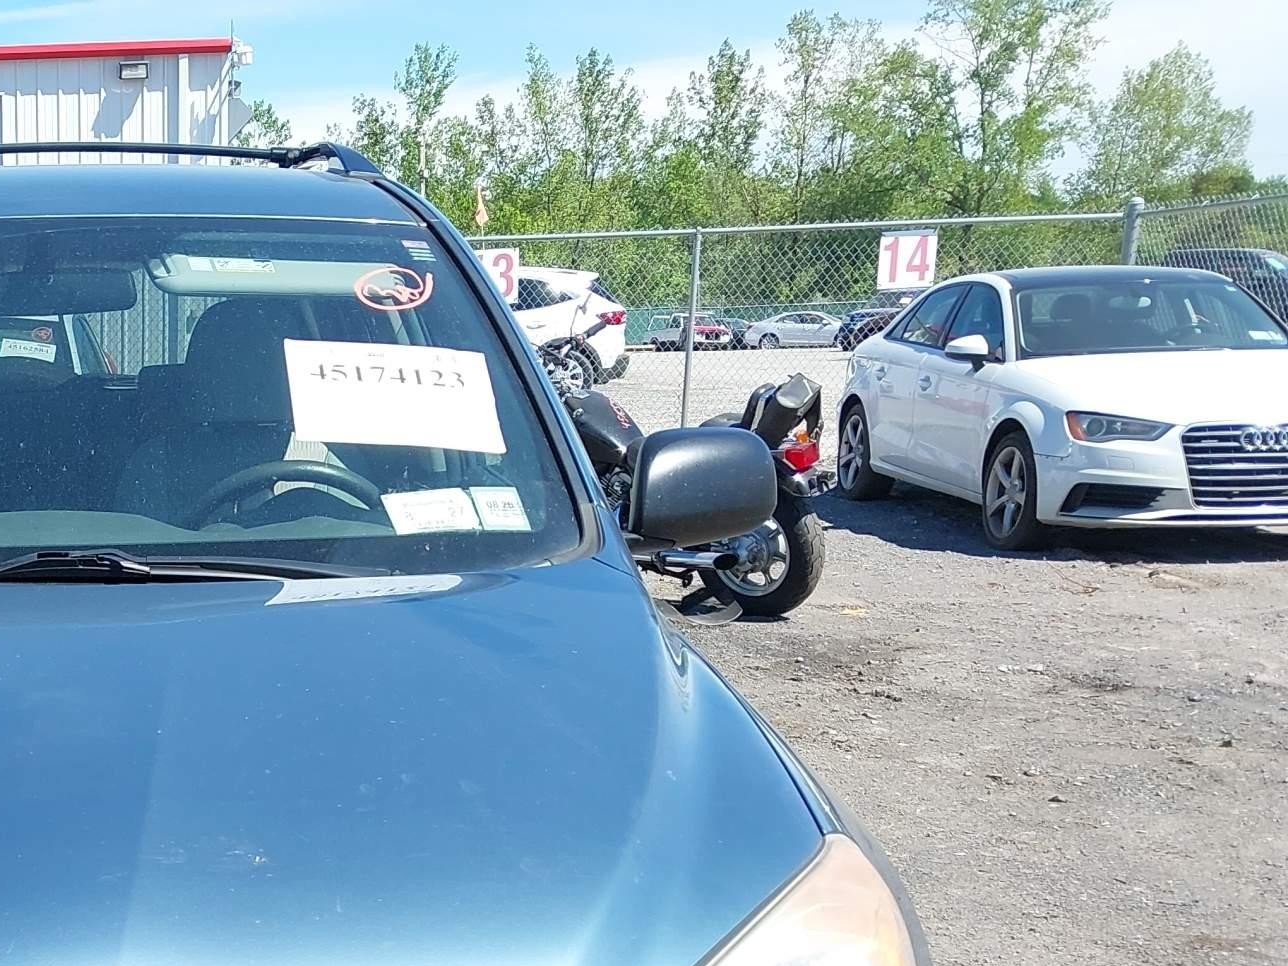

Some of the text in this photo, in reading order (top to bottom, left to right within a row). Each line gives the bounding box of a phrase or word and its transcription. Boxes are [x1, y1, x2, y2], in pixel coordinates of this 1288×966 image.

[478, 253, 514, 298] 3
[883, 234, 930, 283] 14
[310, 363, 465, 388] 45174123
